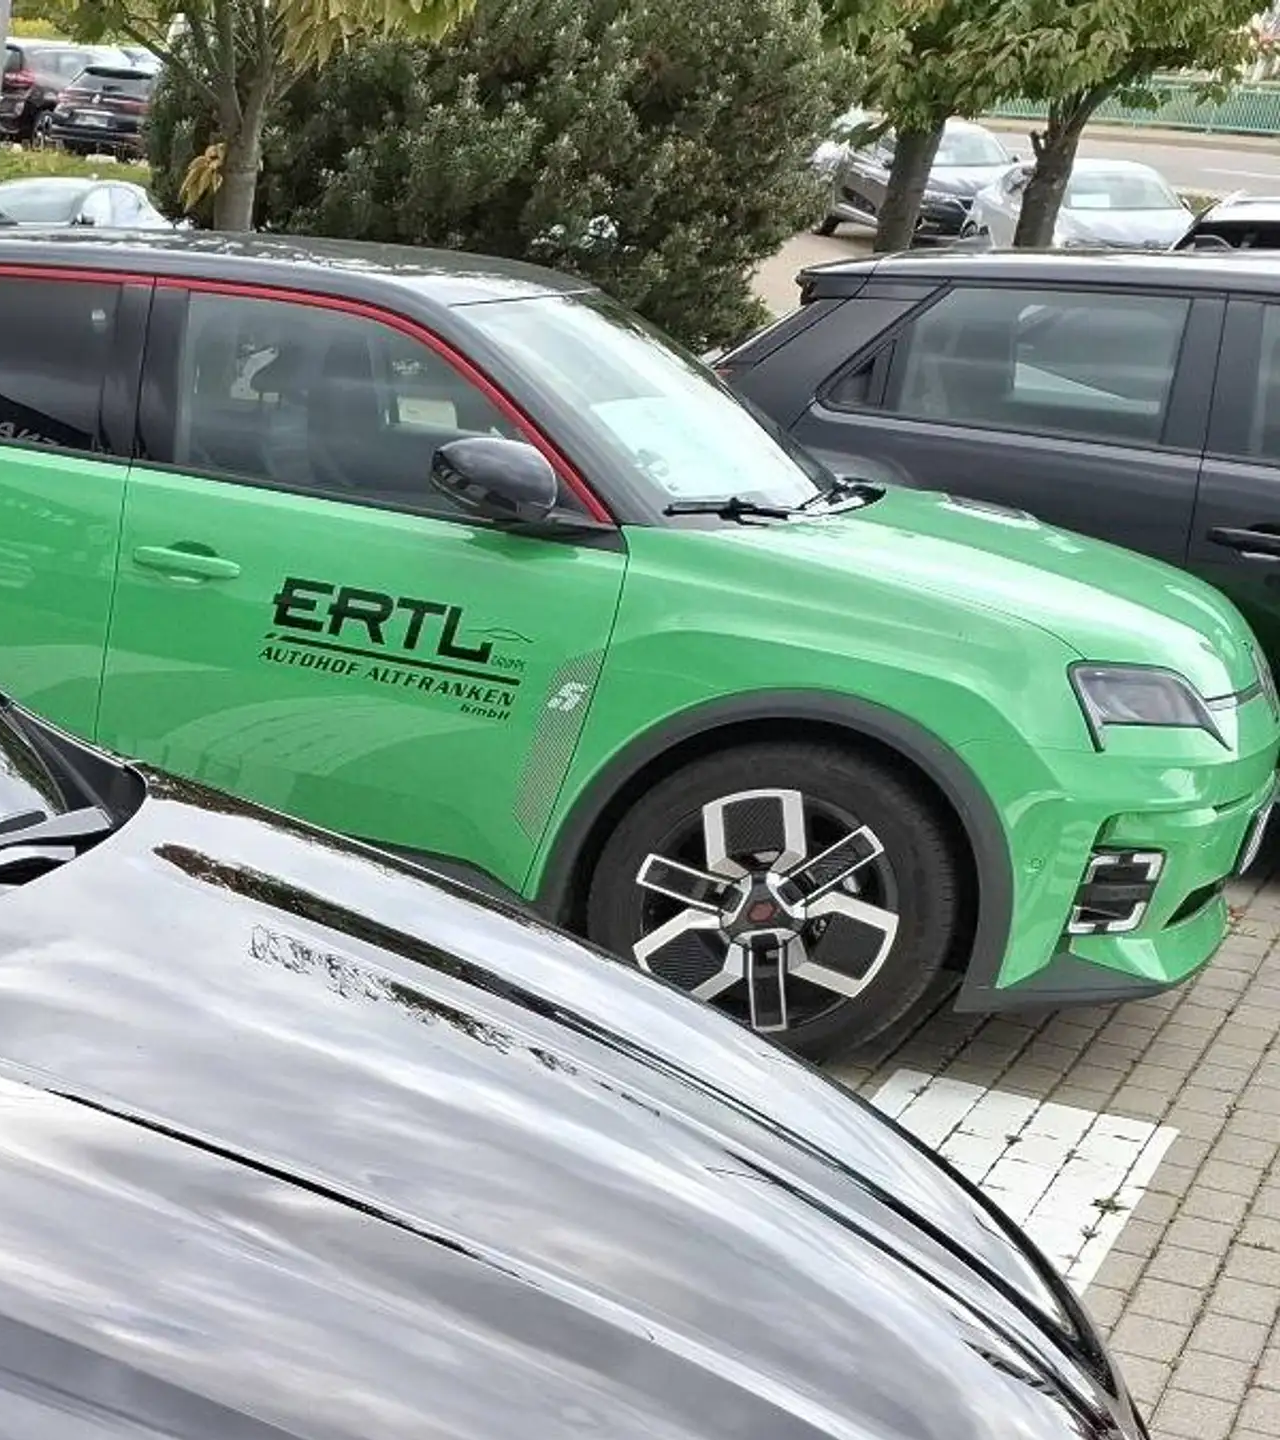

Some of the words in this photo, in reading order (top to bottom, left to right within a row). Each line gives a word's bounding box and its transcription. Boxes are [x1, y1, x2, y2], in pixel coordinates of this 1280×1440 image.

[272, 576, 493, 664] ERTL
[258, 645, 366, 677] AUTOHOF
[367, 666, 517, 707] ALTFRANKEN
